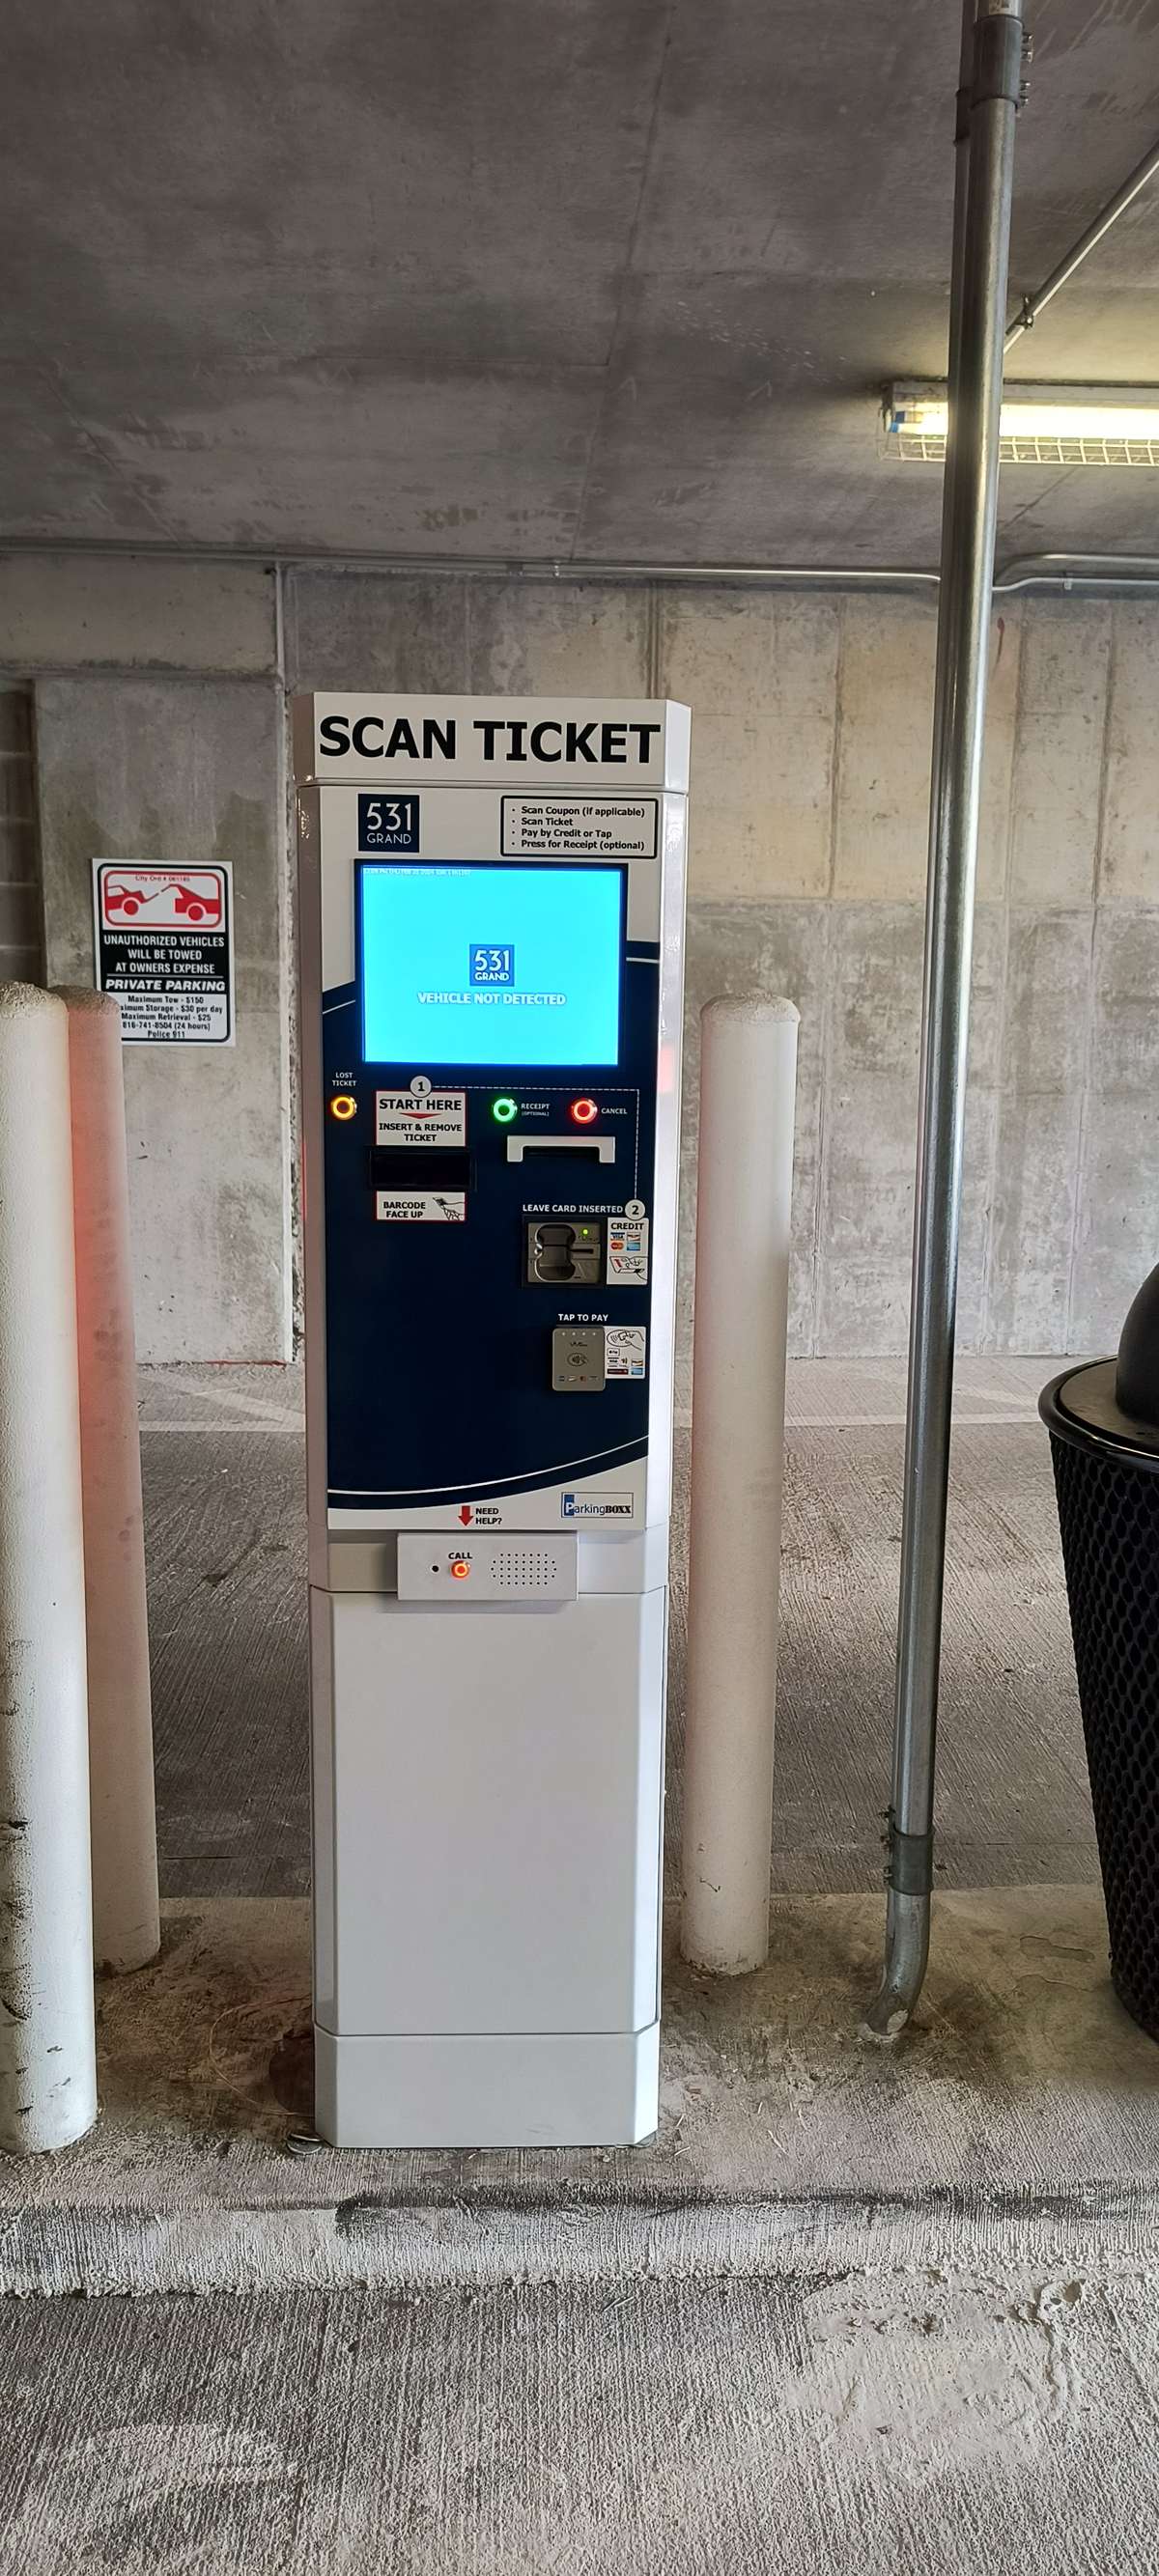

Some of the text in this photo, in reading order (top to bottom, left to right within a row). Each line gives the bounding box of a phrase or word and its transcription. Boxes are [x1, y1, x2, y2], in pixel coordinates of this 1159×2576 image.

[319, 715, 661, 763] SCAN TICKET
[367, 803, 411, 831] 531
[522, 806, 645, 818] Scan Coupon (if applicable)
[522, 817, 573, 826] Scan Ticket
[367, 833, 411, 845] GRAND
[522, 829, 537, 838] Pay
[540, 829, 551, 838] by
[553, 829, 581, 837] Credit
[595, 829, 612, 839] Tap
[548, 840, 562, 848] for
[564, 840, 597, 850] Receipt
[600, 841, 645, 851] (optional)
[104, 935, 225, 947] UNAUTHORIZED VEHICLES
[128, 950, 202, 960] WILL BE TOWED
[474, 950, 510, 971] 531
[115, 963, 215, 974] AT OWNERS EXPENSE
[474, 972, 510, 981] GRAND
[106, 979, 226, 992] PRIVATE PARKING
[417, 992, 566, 1006] VEHICLE NOT DETECTED
[210, 1006, 223, 1014] day
[188, 1022, 210, 1031] hours)
[418, 1081, 425, 1091] 1
[379, 1099, 462, 1111] START HERE
[379, 1123, 413, 1131] INSERT
[631, 1205, 639, 1215] 2
[565, 1502, 631, 1515] ParkingBOXX
